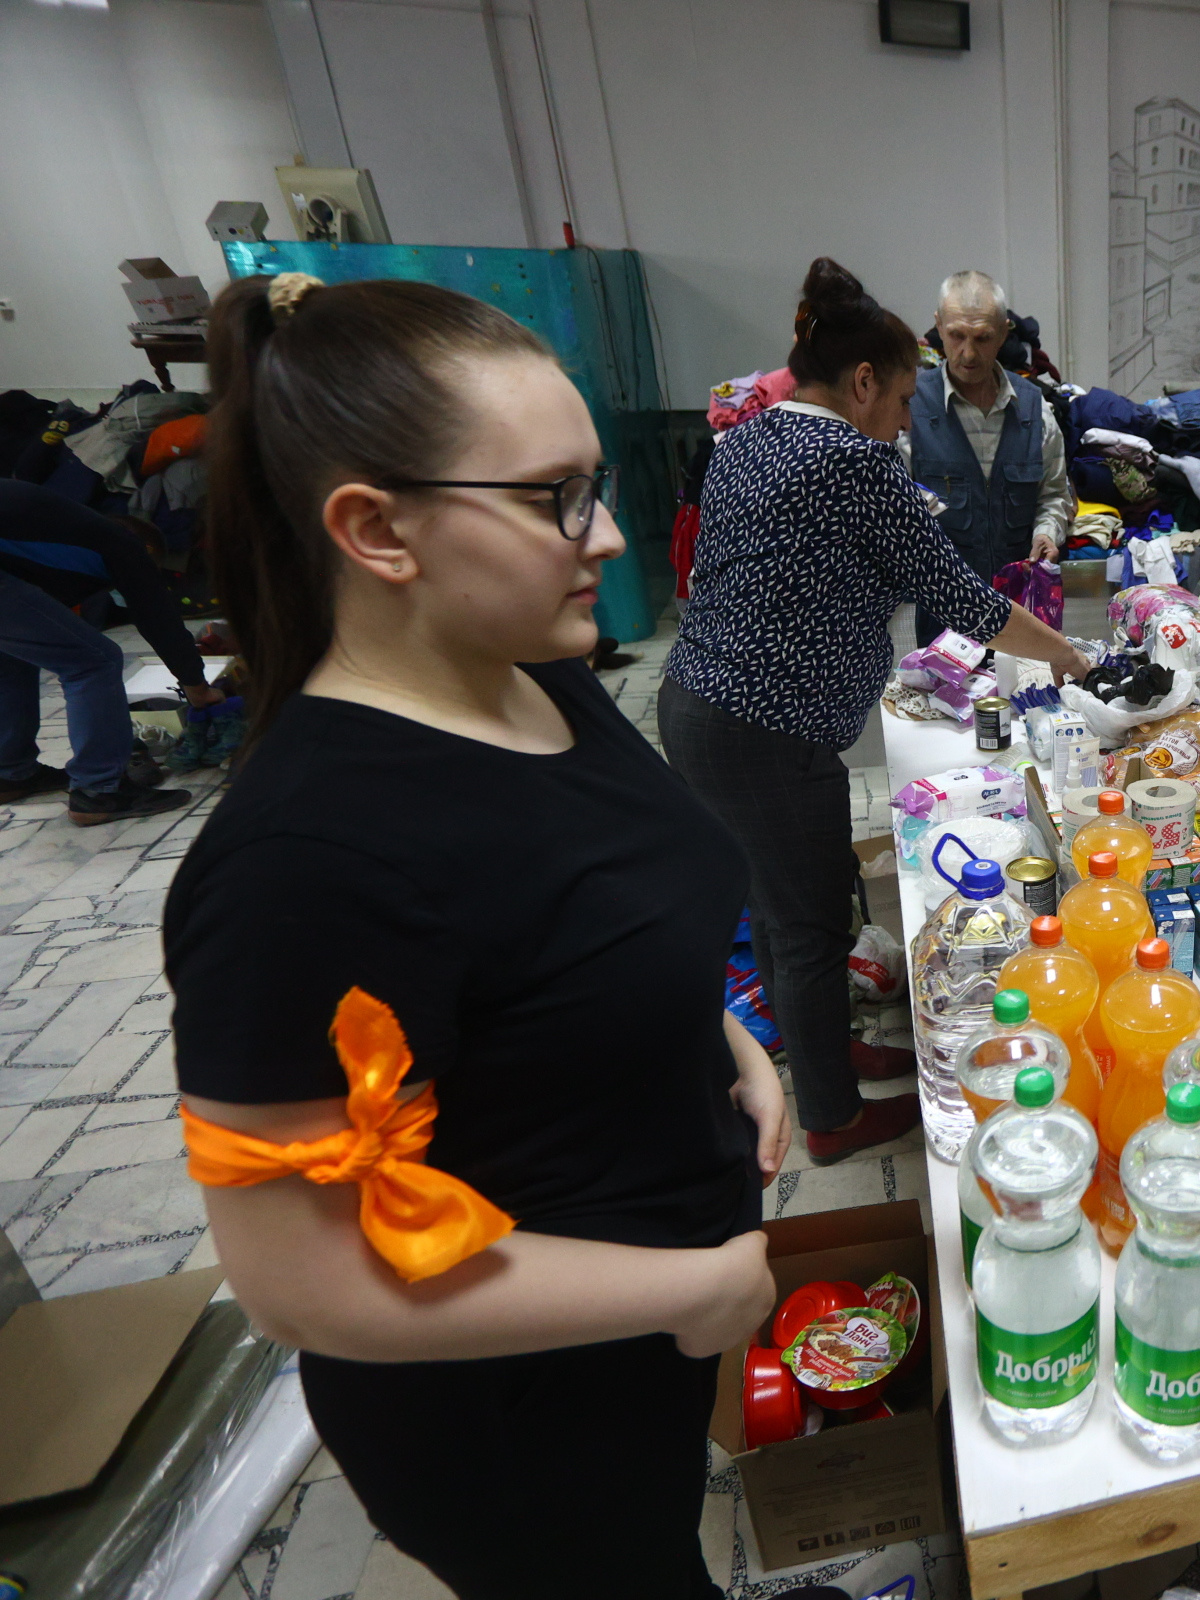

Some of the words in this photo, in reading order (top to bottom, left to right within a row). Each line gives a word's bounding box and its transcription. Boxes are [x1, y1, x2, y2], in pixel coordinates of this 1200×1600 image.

[844, 1331, 872, 1348] Ланч
[854, 1323, 879, 1341] Биг
[995, 1327, 1097, 1384] Добрый
